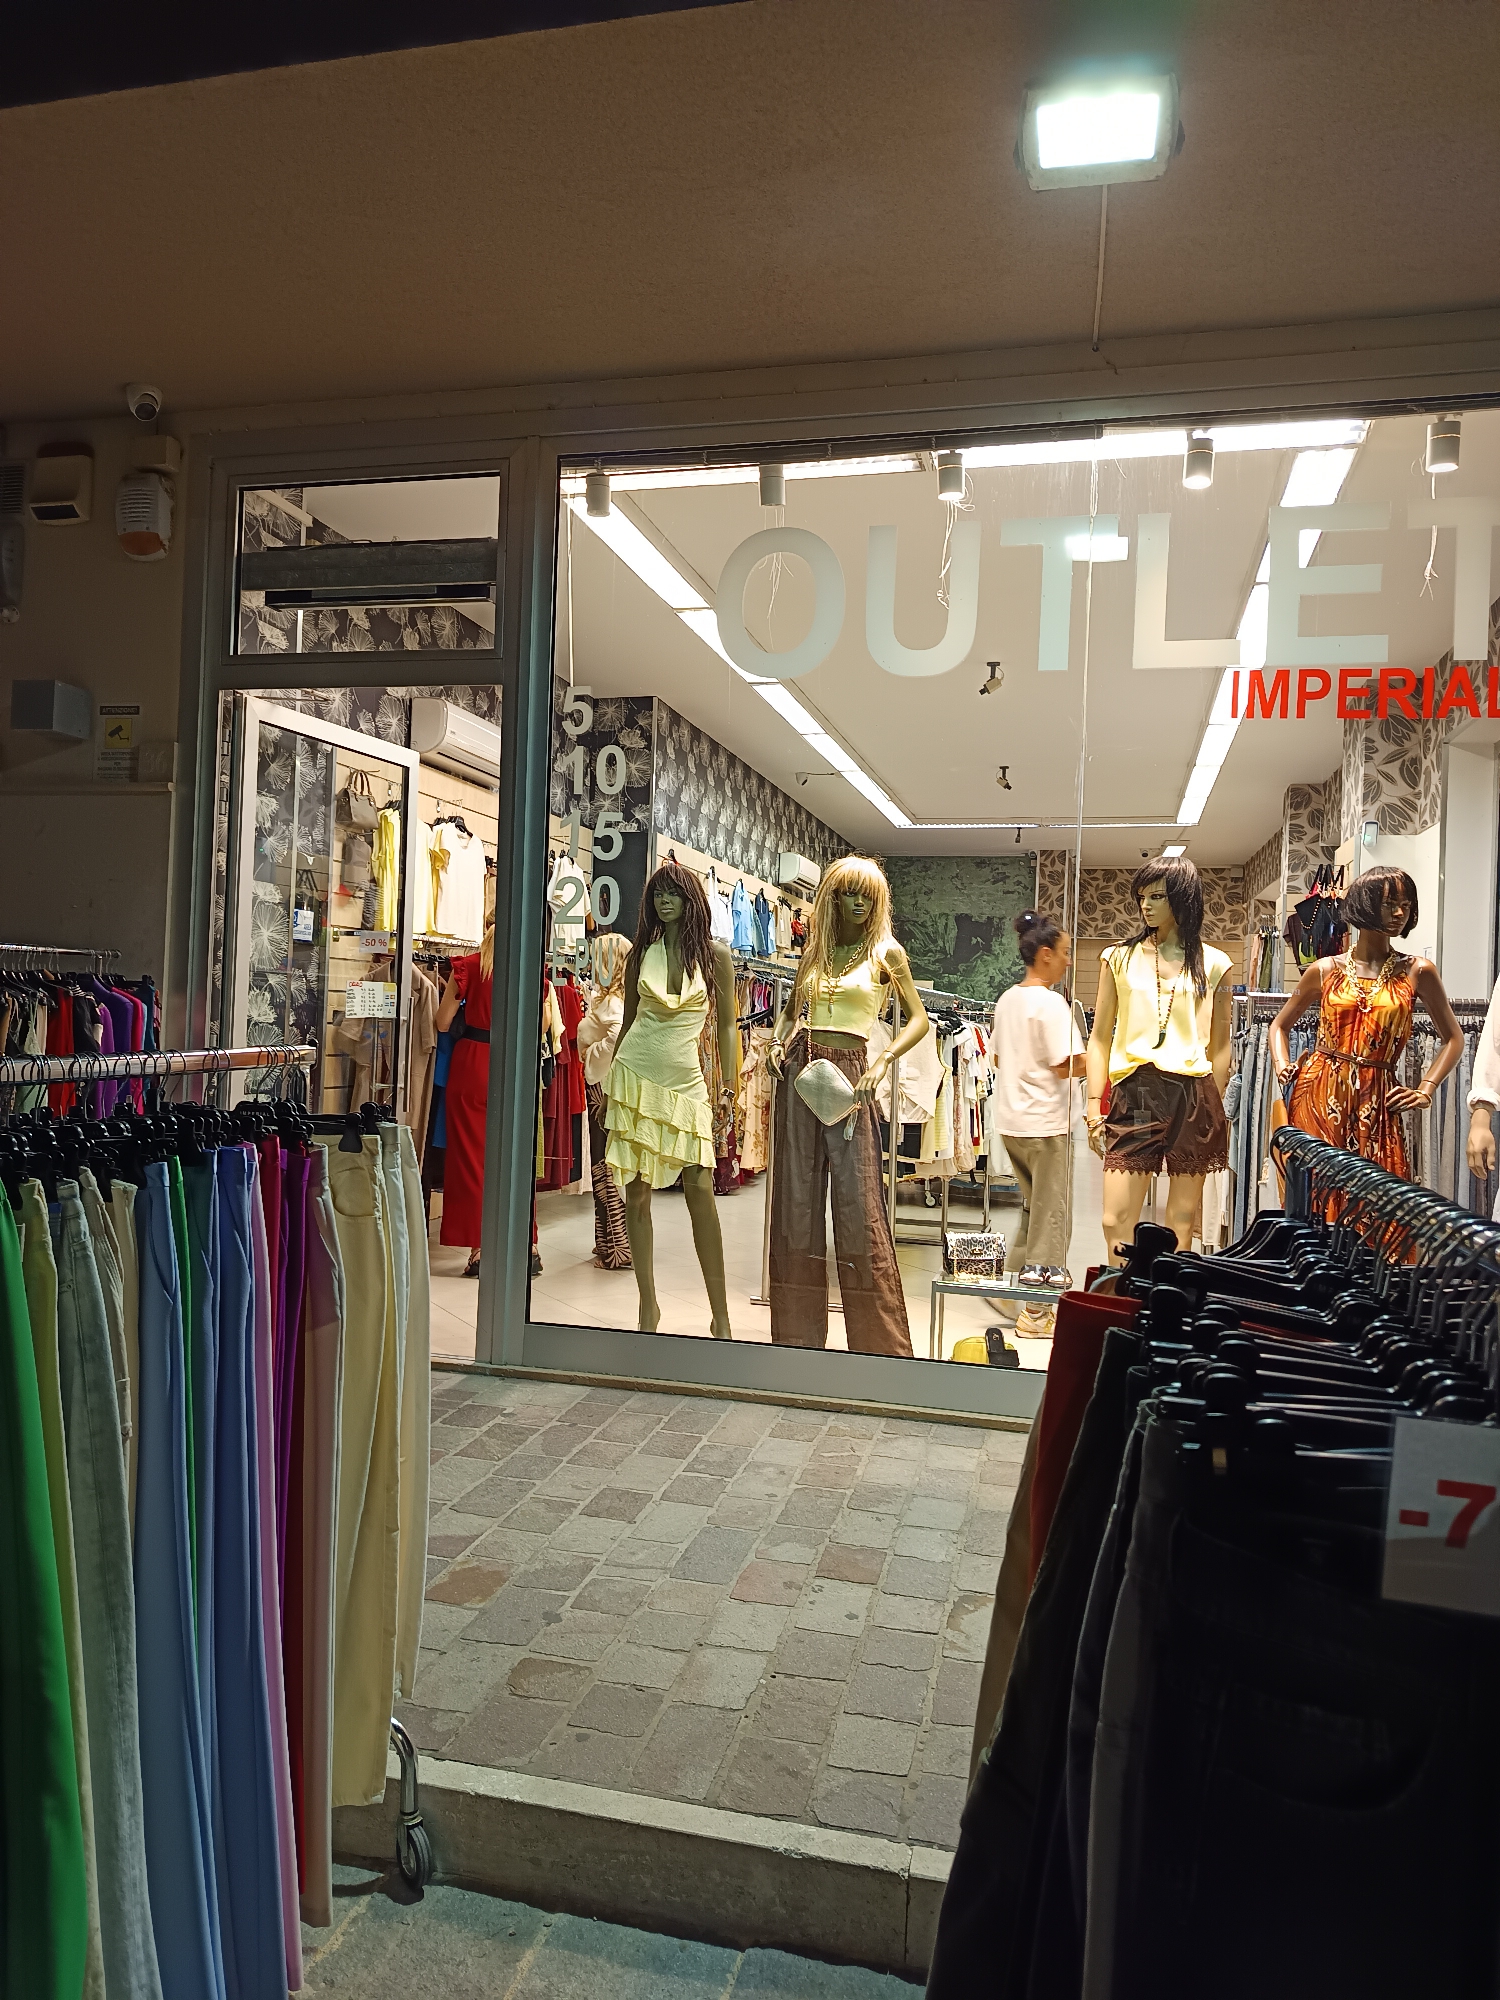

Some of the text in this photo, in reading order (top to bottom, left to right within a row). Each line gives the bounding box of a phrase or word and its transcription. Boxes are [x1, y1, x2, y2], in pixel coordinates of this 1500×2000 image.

[716, 497, 1500, 677] OUTLET
[562, 686, 593, 735] 5
[1231, 666, 1500, 720] IMPERIAL
[563, 744, 626, 794] 10
[560, 809, 623, 861] 15
[554, 876, 620, 925] 20
[361, 938, 387, 947] -50 %
[552, 938, 566, 986] E
